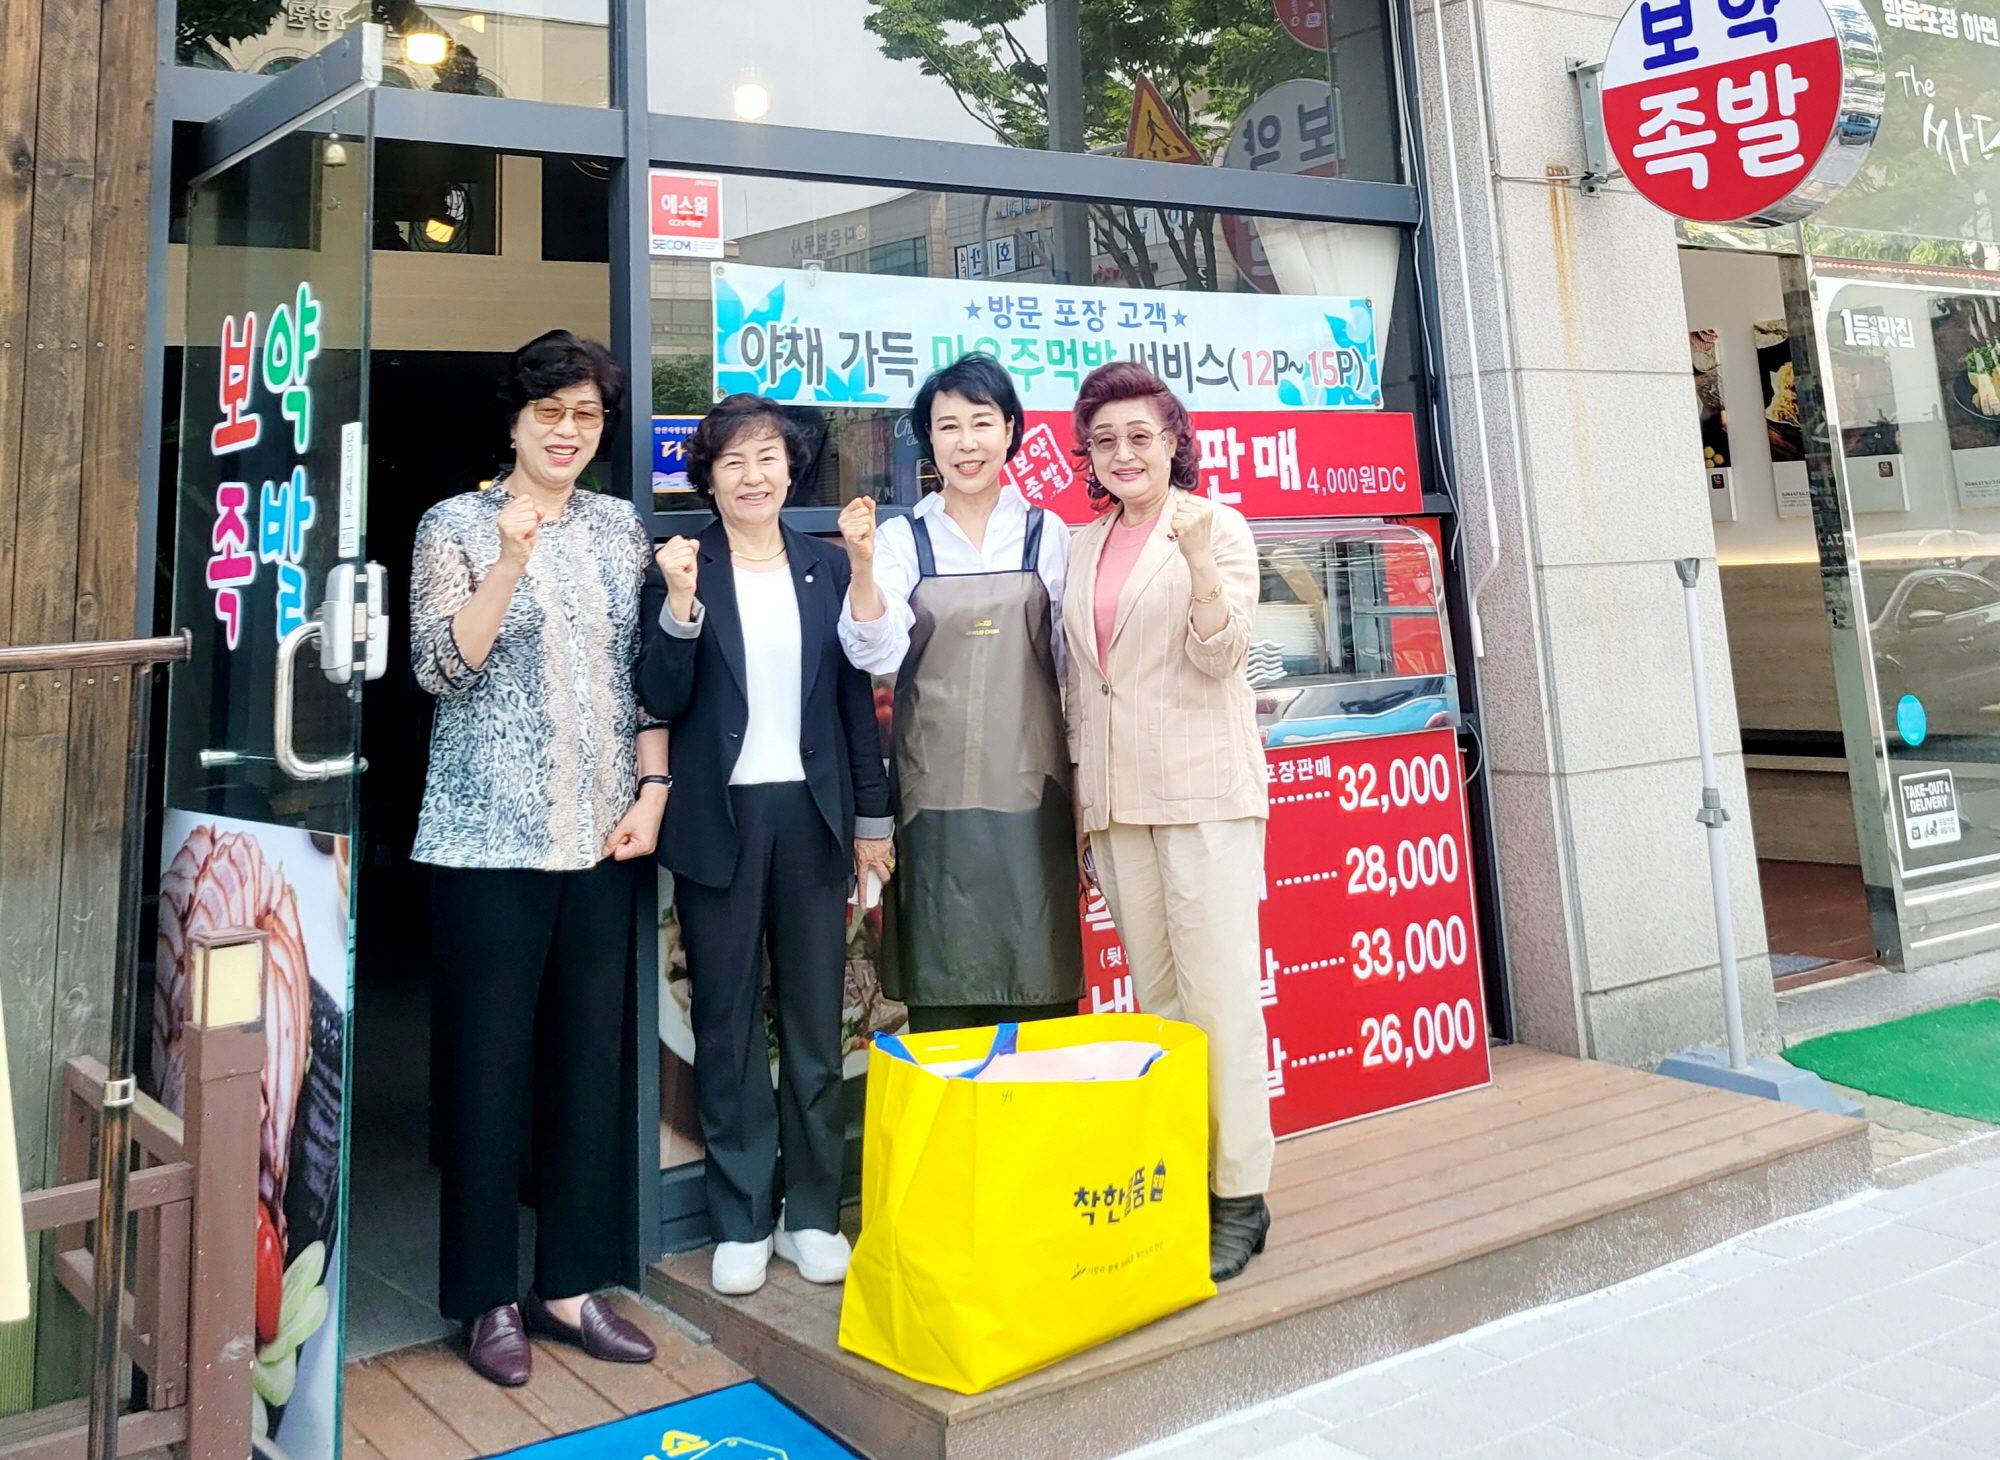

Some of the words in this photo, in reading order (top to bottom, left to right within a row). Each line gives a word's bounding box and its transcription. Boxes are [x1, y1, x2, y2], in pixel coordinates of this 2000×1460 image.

[1895, 64, 1937, 98] The
[1633, 63, 1809, 190] 족발
[661, 194, 708, 217] 에스원
[652, 240, 691, 251] SECOM
[988, 295, 1043, 330] 방문
[1054, 299, 1106, 333] 포장
[1117, 302, 1168, 334] 고객
[211, 281, 322, 456] 보약
[741, 324, 824, 386] 야채
[839, 330, 919, 389] 가득
[1307, 465, 1407, 496] 4,000원DC
[206, 465, 315, 651] 족발
[1338, 754, 1450, 813] 32,000
[1910, 795, 1948, 813] DELIVERY
[1346, 834, 1458, 897] 28,000
[1352, 915, 1467, 982] 33,000
[1361, 998, 1475, 1069] 26,000
